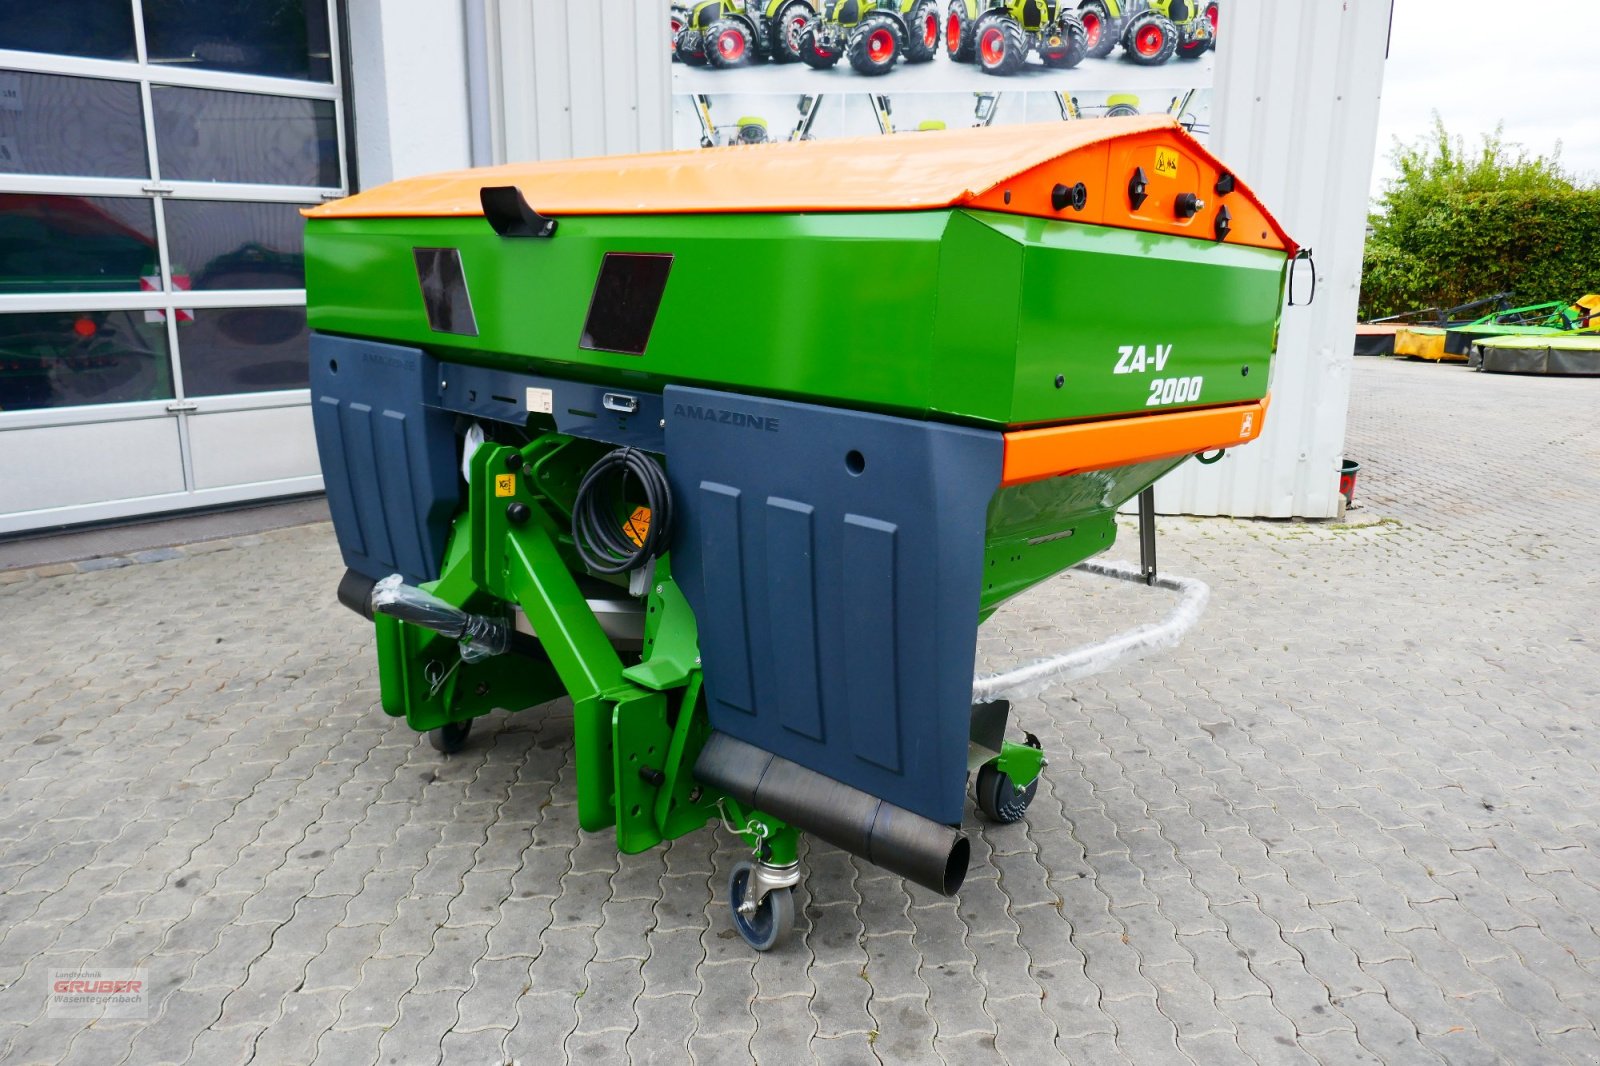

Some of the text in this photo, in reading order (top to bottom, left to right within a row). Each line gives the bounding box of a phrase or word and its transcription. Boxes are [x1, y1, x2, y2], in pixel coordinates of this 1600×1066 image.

[1113, 344, 1172, 374] ZA-V
[1146, 376, 1203, 406] 2000
[673, 403, 780, 432] AMAZONE
